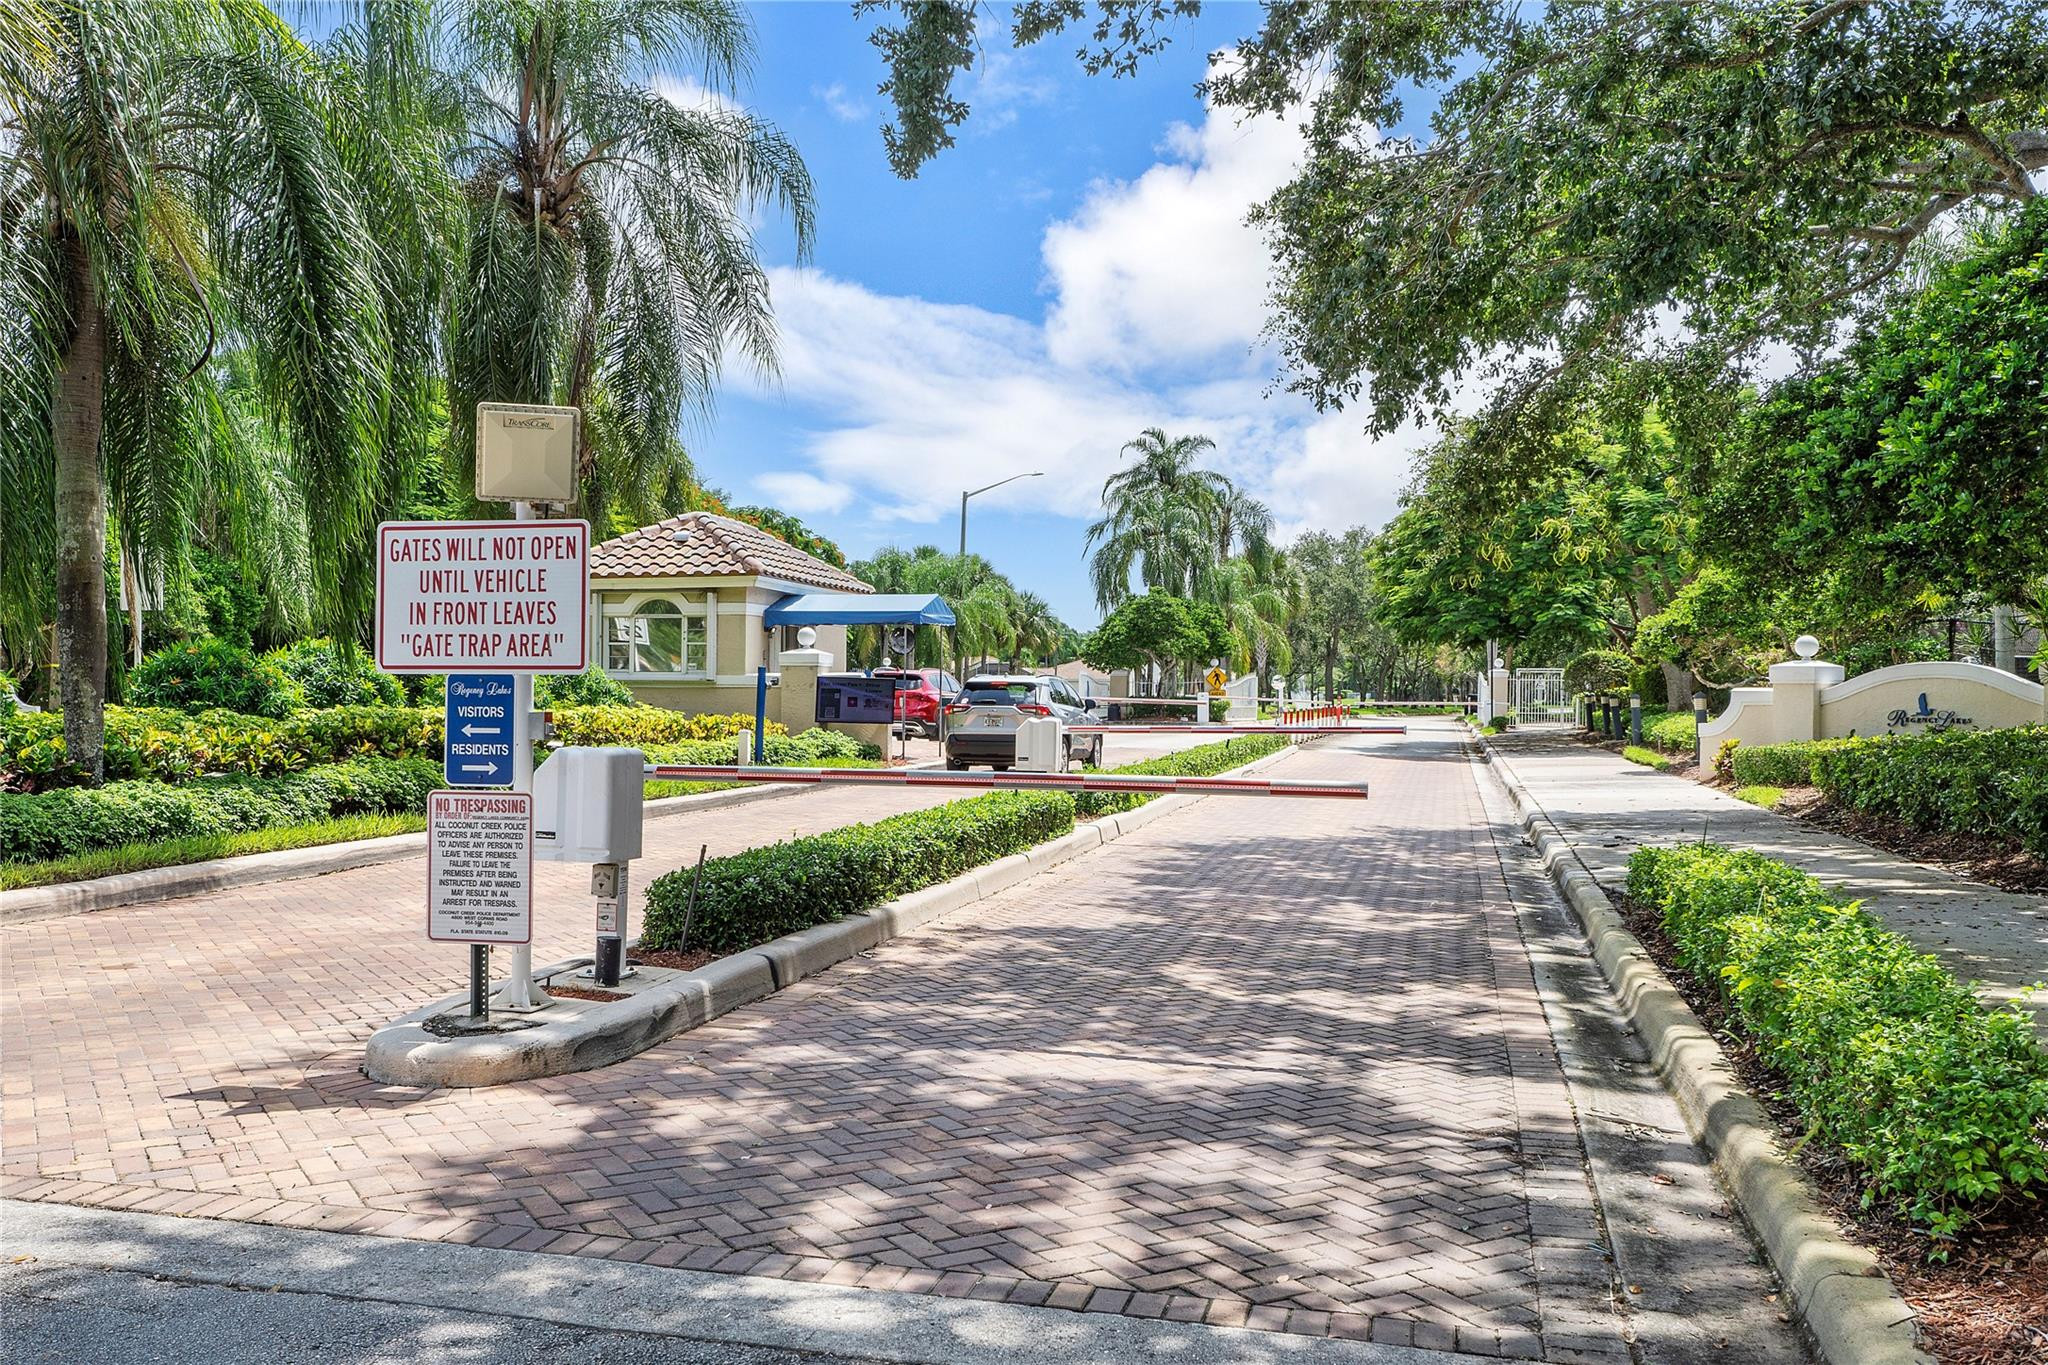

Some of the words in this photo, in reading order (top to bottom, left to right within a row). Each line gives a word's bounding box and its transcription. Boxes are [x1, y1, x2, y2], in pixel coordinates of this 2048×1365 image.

[390, 539, 441, 562] GATES
[446, 538, 487, 561] WILL
[493, 537, 525, 560] NOT
[531, 536, 577, 560] OPEN
[419, 570, 469, 593] UNTIL
[474, 569, 547, 593] VEHICLE
[409, 602, 426, 625] IN
[433, 602, 486, 625] FRONT
[493, 601, 557, 625] LEAVES
[401, 634, 453, 657] "GATE
[459, 633, 502, 658] TRAP
[506, 633, 564, 657] AREA"
[450, 682, 484, 698] Regency
[486, 682, 512, 696] Lakes
[458, 706, 504, 717] VISITORS
[452, 744, 509, 755] RESIDENTS
[436, 798, 450, 812] NO
[453, 799, 526, 813] TRESPASSING
[444, 812, 462, 820] ORDER
[435, 821, 446, 829] ALL
[481, 822, 502, 830] CREEK
[437, 831, 468, 839] OFFICERS
[470, 831, 483, 839] ARE
[485, 832, 524, 840] AUTHORIZED
[438, 840, 446, 848] TO
[472, 841, 485, 849] ANY
[515, 842, 523, 850] TO
[442, 850, 461, 858] LEAVE
[485, 851, 518, 859] PREMISES.
[473, 860, 480, 868] TO
[500, 861, 511, 869] THE
[443, 869, 474, 877] PREMISES
[476, 870, 496, 878] AFTER
[498, 871, 517, 879] BEING
[439, 879, 477, 887] INSTRUCTED
[466, 889, 489, 897] RESULT
[442, 898, 467, 906] ARREST
[484, 900, 518, 908] TRESPASS.
